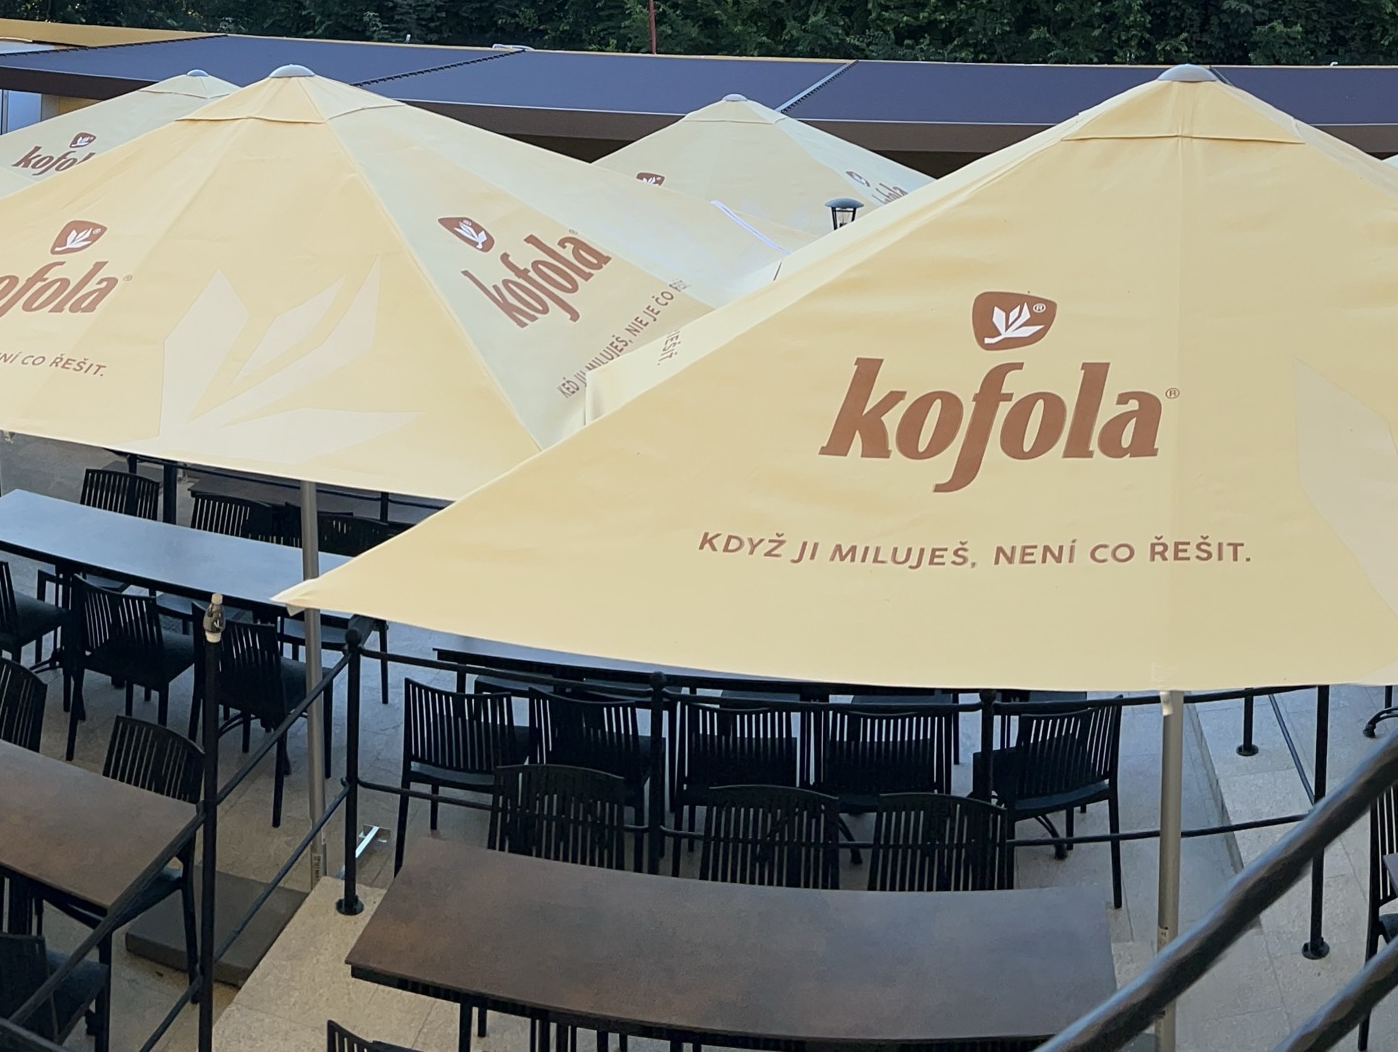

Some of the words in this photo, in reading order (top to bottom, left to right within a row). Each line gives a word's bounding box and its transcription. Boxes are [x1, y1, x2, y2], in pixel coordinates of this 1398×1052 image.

[11, 146, 96, 176] kofo
[461, 234, 612, 328] kofola
[625, 316, 649, 337] NIE
[643, 305, 660, 322] JE
[652, 291, 674, 307] ČO
[21, 355, 46, 366] CO
[49, 354, 107, 377] ŘEŠIT.
[818, 357, 1162, 493] kofola
[699, 531, 787, 558] KDYŽ
[791, 541, 819, 565] JI
[829, 541, 978, 570] MILUJEŠ,
[994, 539, 1077, 567] NENÍ
[1089, 543, 1136, 564] CO
[1149, 535, 1252, 563] ŘEŠIT.
